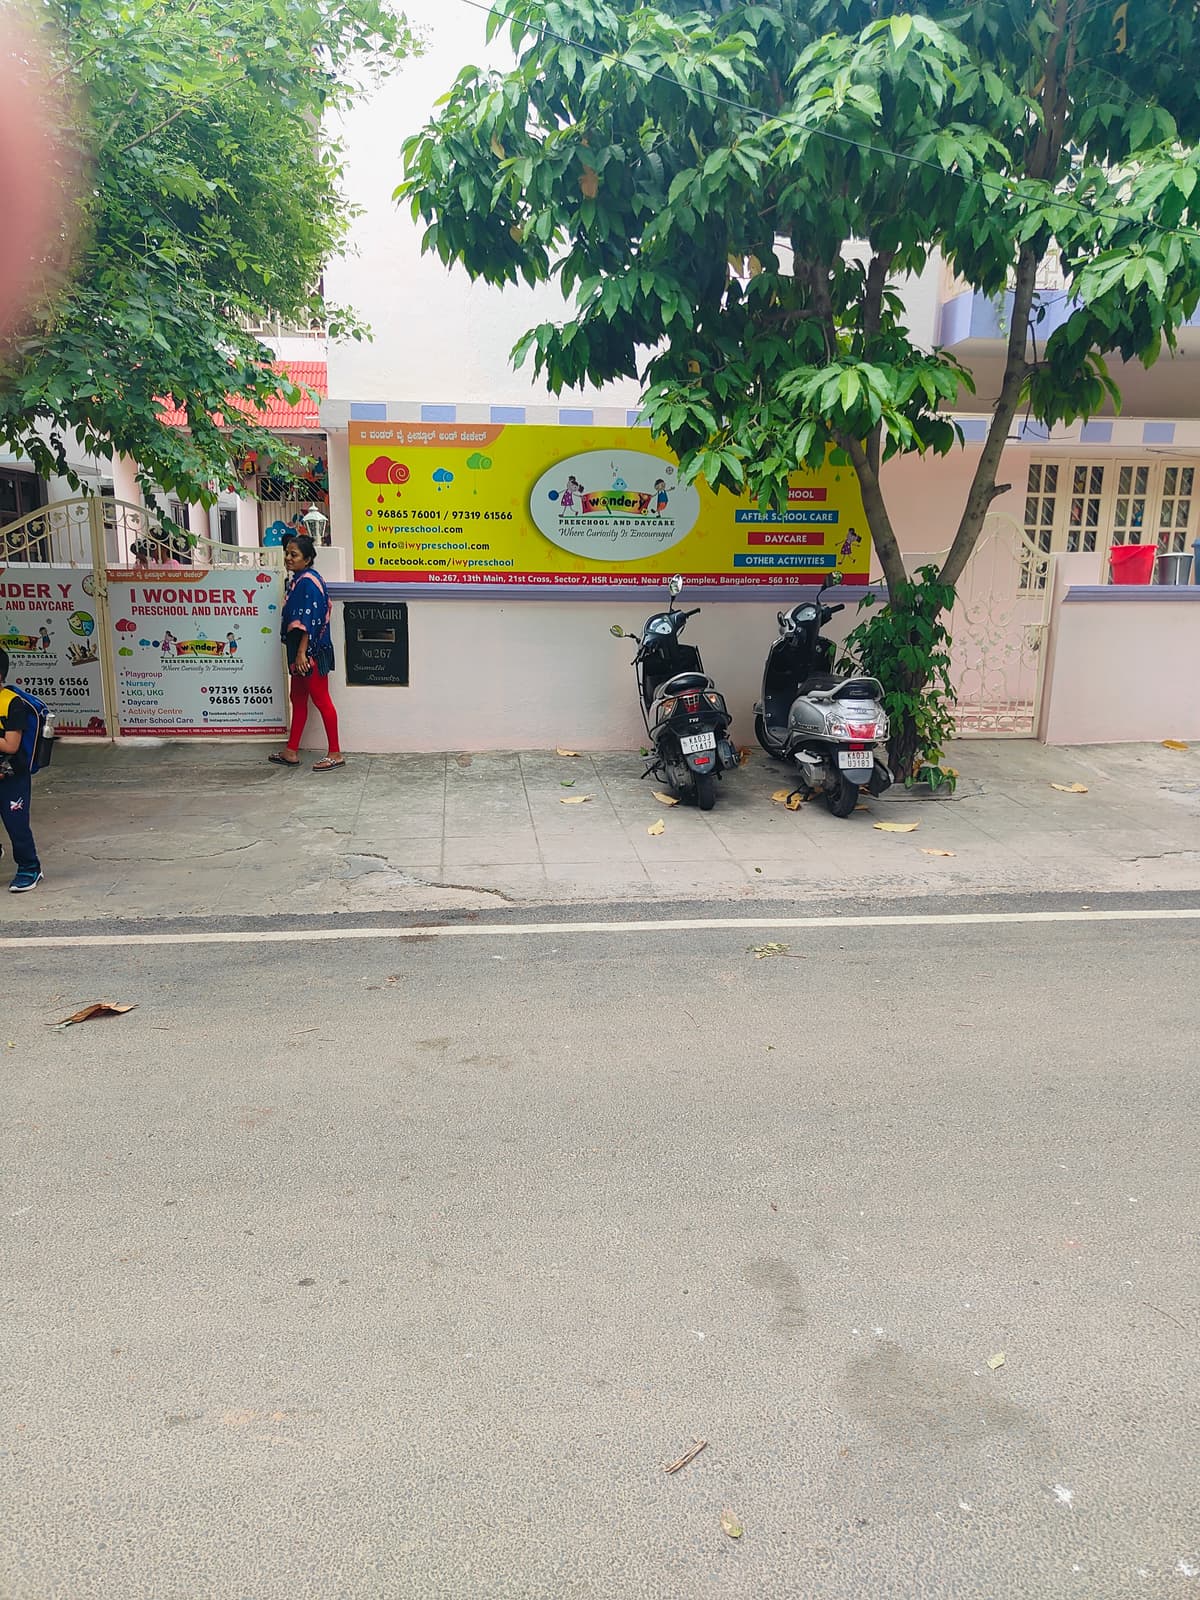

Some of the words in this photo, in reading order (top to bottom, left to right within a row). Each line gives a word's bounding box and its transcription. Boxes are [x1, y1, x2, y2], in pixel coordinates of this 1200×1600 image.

[377, 510, 408, 519] 96865
[411, 510, 441, 519] 76001
[452, 511, 481, 520] 97319
[484, 511, 513, 520] 61566
[741, 513, 768, 521] AFTER
[771, 513, 807, 521] SCHOOL
[809, 513, 833, 521] CARE
[634, 519, 675, 527] DAYCARE
[377, 524, 463, 534] iwypreschool.com
[558, 526, 585, 538] Where
[586, 528, 619, 541] Curiosity
[620, 528, 629, 538] Is
[630, 528, 675, 542] Encouraged
[764, 535, 808, 543] DAYCARE
[378, 540, 490, 551] info@iwypreschool.com
[379, 557, 514, 567] facebook.com/iwypreschool
[745, 557, 775, 565] OTHER
[777, 557, 825, 565] ACTIVITIES
[428, 574, 460, 582] No.267,
[462, 574, 481, 582] 13th
[483, 574, 506, 583] Main,
[508, 574, 525, 583] 21st
[527, 575, 552, 584] Cross,
[554, 575, 580, 584] Sector
[582, 576, 590, 584] 7,
[591, 576, 607, 584] HSR
[609, 576, 639, 586] Layout,
[720, 577, 760, 585] Bangalore
[57, 584, 72, 598] Y
[130, 589, 136, 603] I
[142, 589, 237, 604] WONDER
[242, 590, 257, 604] Y
[6, 601, 25, 610] AND
[29, 601, 74, 611] DAYCARE
[132, 606, 189, 615] PRESCHOOL
[192, 606, 211, 616] AND
[215, 606, 259, 616] DAYCARE
[349, 608, 402, 620] SAPTAGIRI
[125, 671, 163, 679] Playgroup
[24, 677, 54, 686] 97319
[59, 677, 89, 686] 61566
[25, 688, 57, 696] 96865
[61, 688, 90, 696] 76001
[208, 686, 238, 694] 97319
[243, 686, 273, 694] 61566
[209, 696, 240, 704] 96865
[243, 696, 273, 704] 76001
[128, 708, 156, 716] Activity
